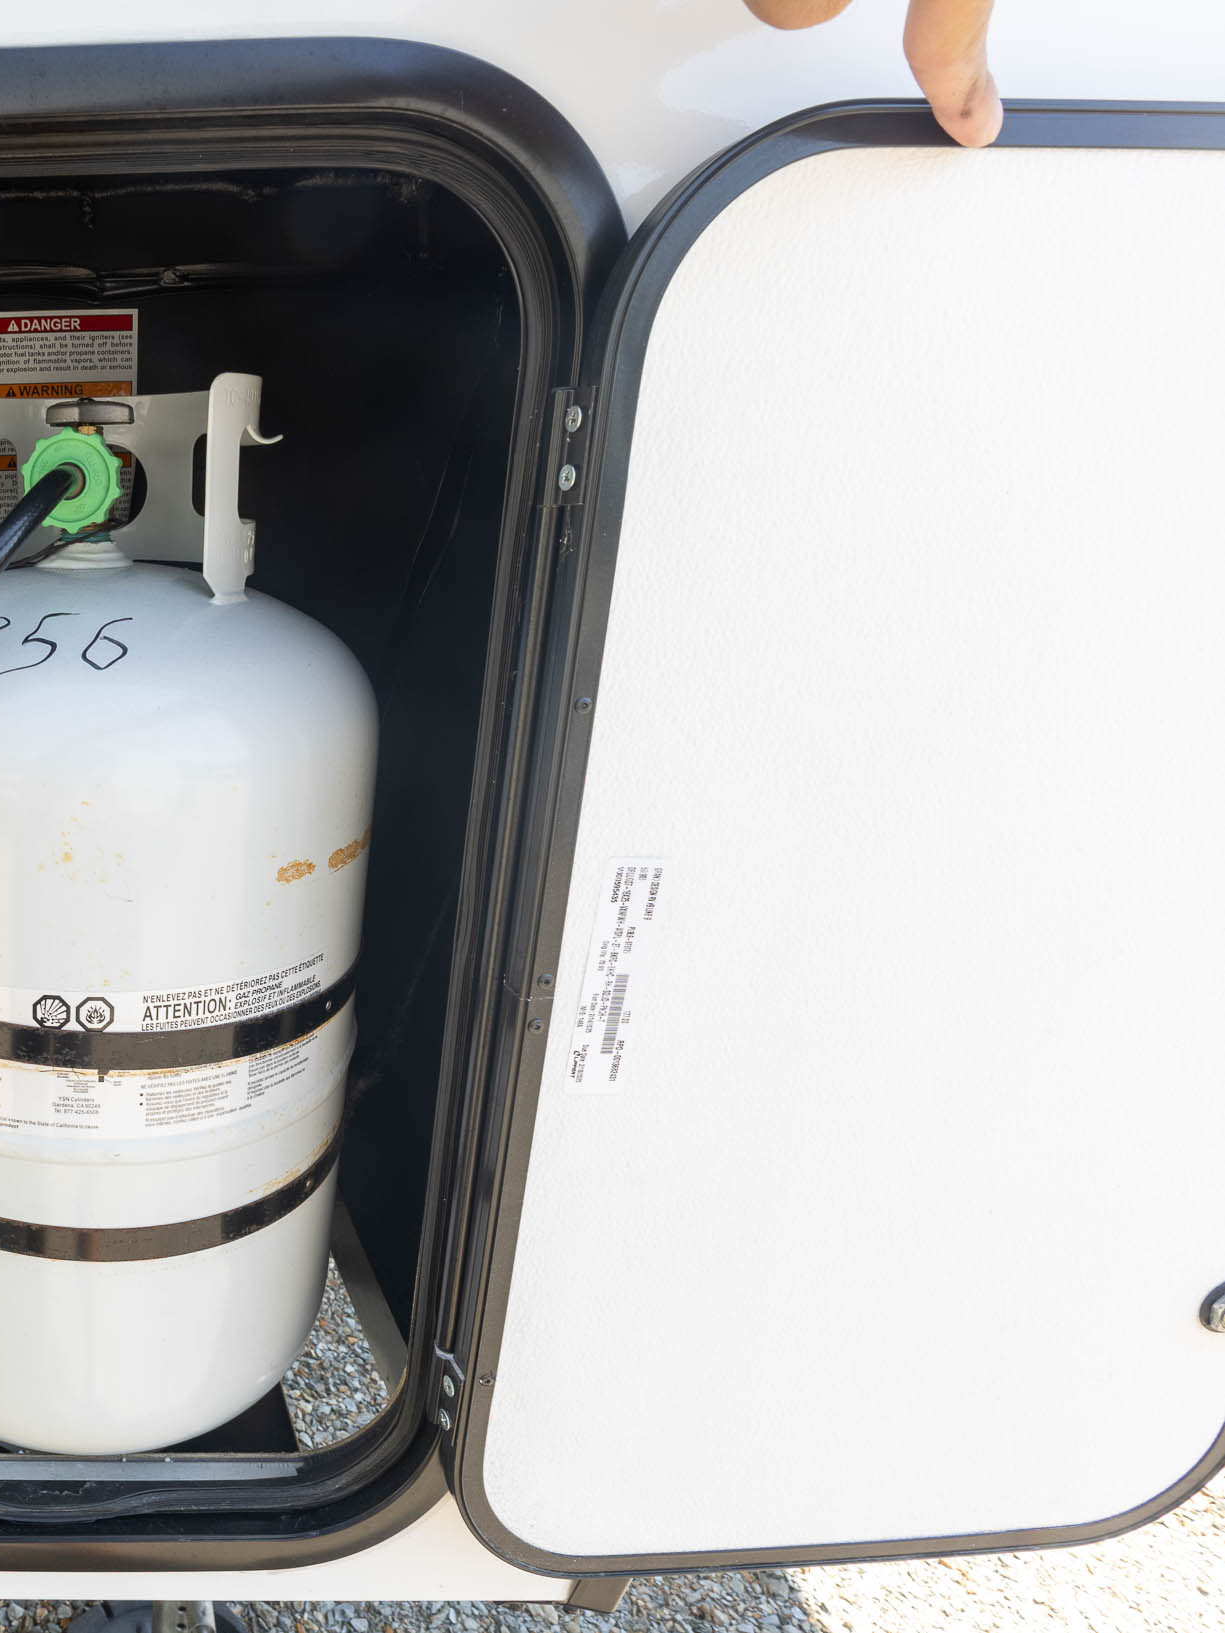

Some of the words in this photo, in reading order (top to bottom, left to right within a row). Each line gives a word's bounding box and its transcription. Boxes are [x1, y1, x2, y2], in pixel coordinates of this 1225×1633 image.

[21, 318, 80, 331] DANGER
[12, 335, 50, 343] appliances,
[89, 333, 115, 342] igniters
[119, 333, 132, 341] (see
[69, 349, 95, 357] propane
[7, 365, 37, 373] explosion
[19, 384, 83, 397] WARNING
[143, 992, 186, 1004] N'ENLEVEZ
[187, 990, 202, 1000] PAS
[204, 989, 213, 998] ET
[215, 986, 225, 996] NE
[268, 972, 280, 981] PAS
[280, 965, 298, 979] CETTE
[234, 995, 267, 1010] EXPLOSIF
[268, 992, 276, 1000] ET
[277, 974, 316, 997] INFLAMMABLE
[236, 991, 250, 1001] GAZ
[251, 981, 283, 997] PROPANE
[141, 1023, 154, 1031] LES
[155, 1021, 178, 1030] FUITES
[179, 1016, 209, 1028] PEUVENT
[210, 1007, 252, 1023] OCCASIONNER
[253, 1004, 264, 1013] DES
[265, 1000, 277, 1010] FEUX
[278, 997, 286, 1005] OU
[286, 994, 295, 1002] DES
[142, 996, 232, 1021] ATTENTION:
